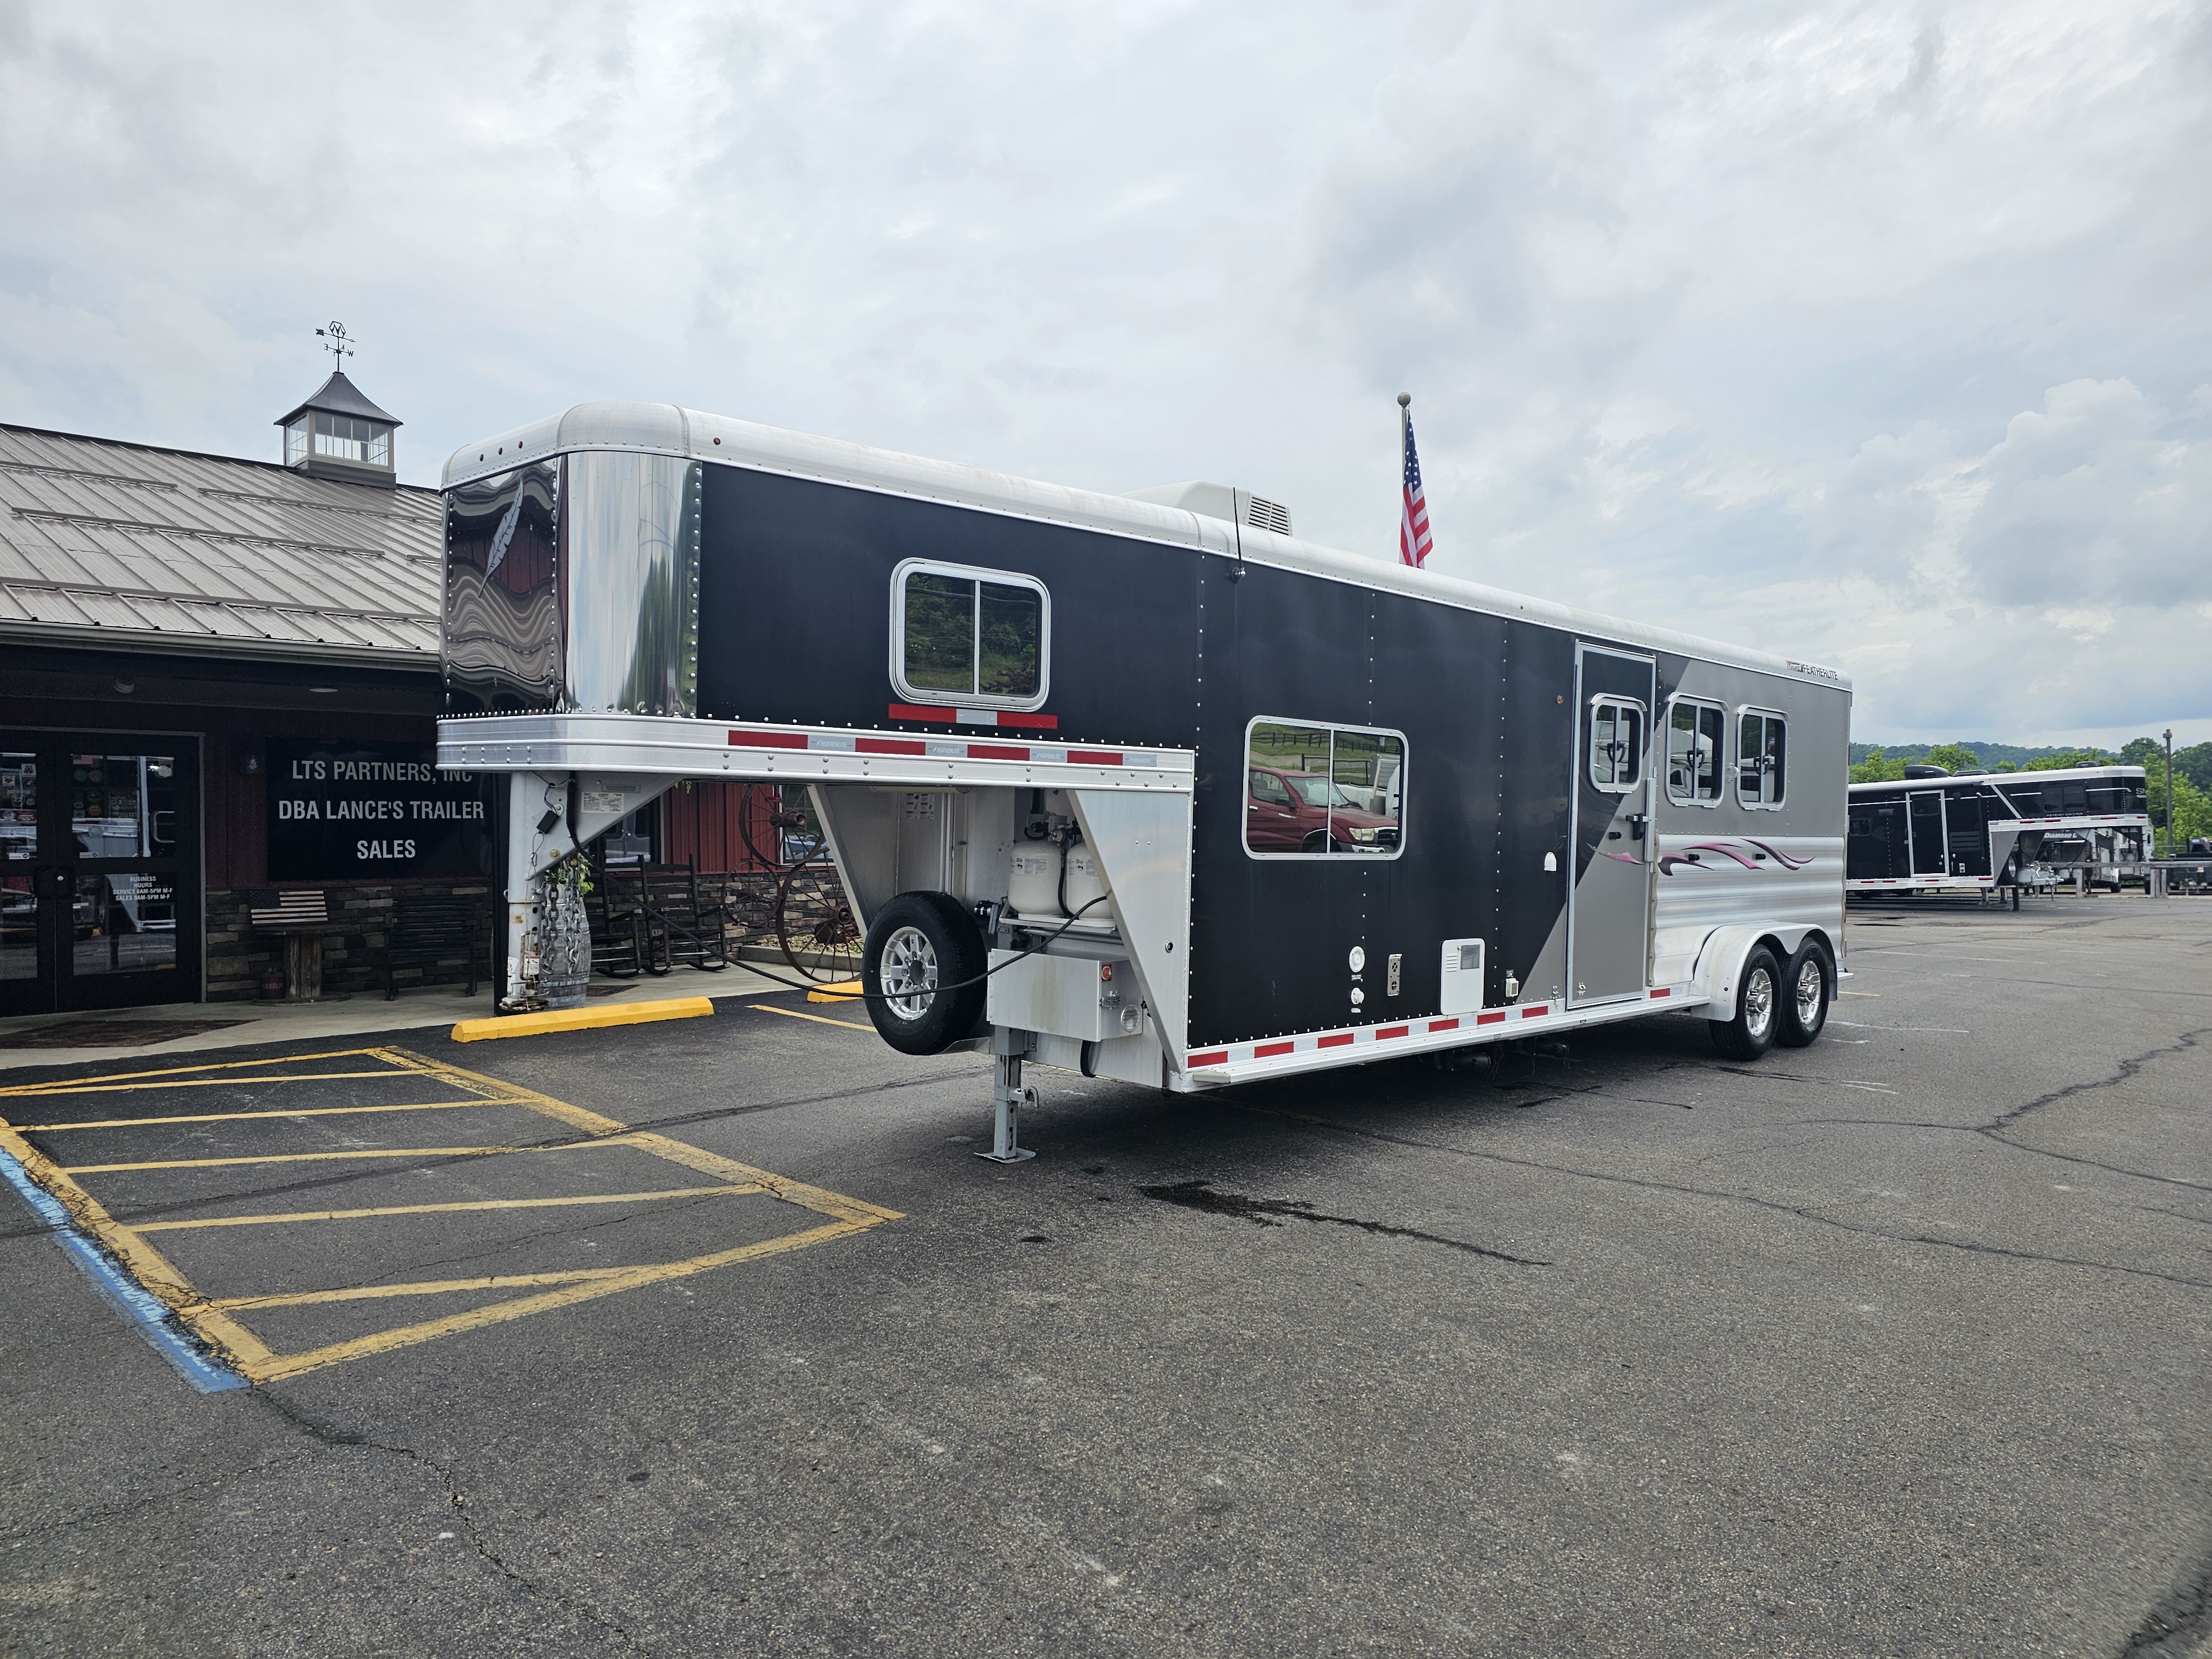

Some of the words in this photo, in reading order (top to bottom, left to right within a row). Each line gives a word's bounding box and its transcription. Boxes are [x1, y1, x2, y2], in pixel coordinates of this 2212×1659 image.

[1802, 664, 1838, 680] FEATHERLITE
[293, 760, 326, 780] LTS
[334, 761, 436, 784] PARTNERS,
[279, 801, 320, 819] DBA
[326, 800, 404, 819] LANCE'S
[410, 801, 484, 819] TRAILER
[357, 839, 416, 859] SALES
